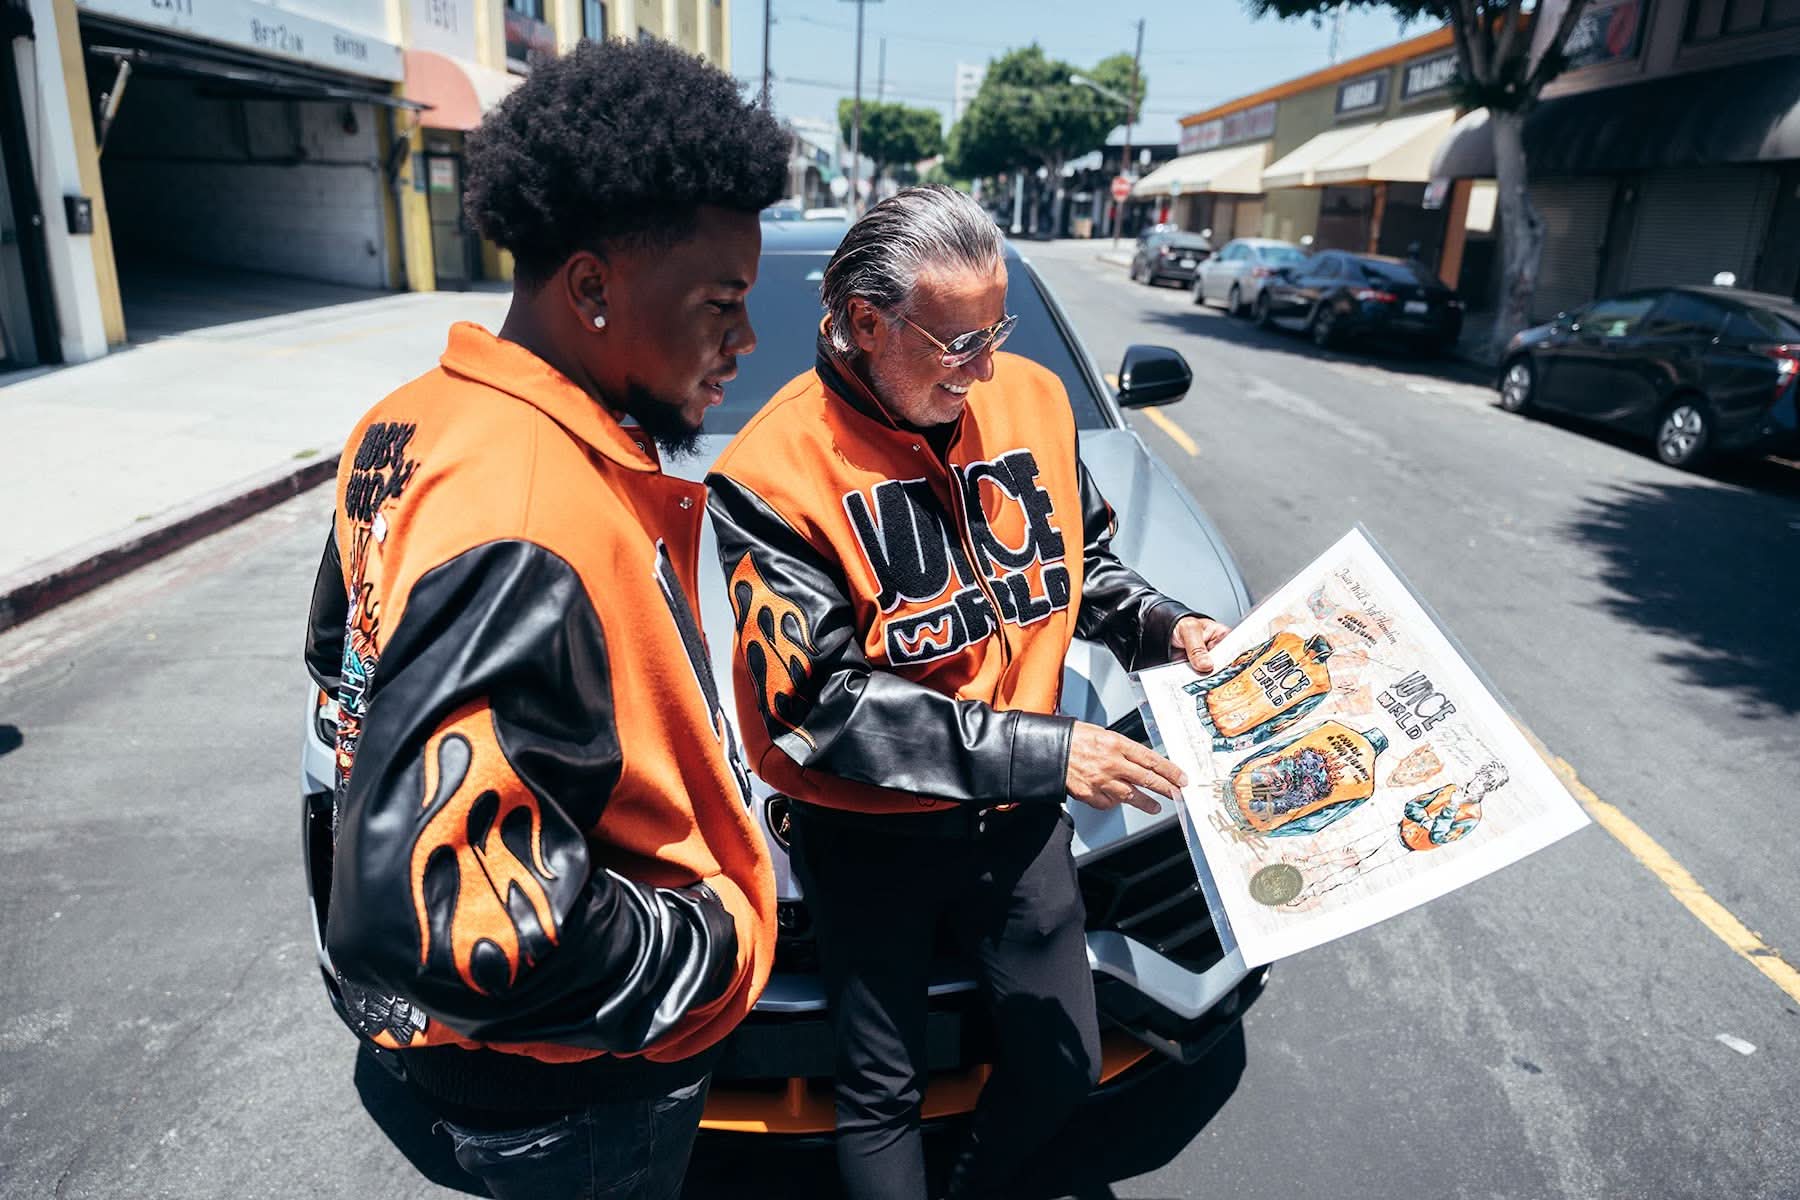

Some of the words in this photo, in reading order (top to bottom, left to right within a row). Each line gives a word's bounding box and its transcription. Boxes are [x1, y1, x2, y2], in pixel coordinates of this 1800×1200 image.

[842, 448, 1066, 614] JUICE
[884, 563, 1071, 667] WRLD
[1262, 650, 1310, 700] JUICE
[1390, 670, 1456, 731] JUICE
[1376, 691, 1422, 739] WRLD
